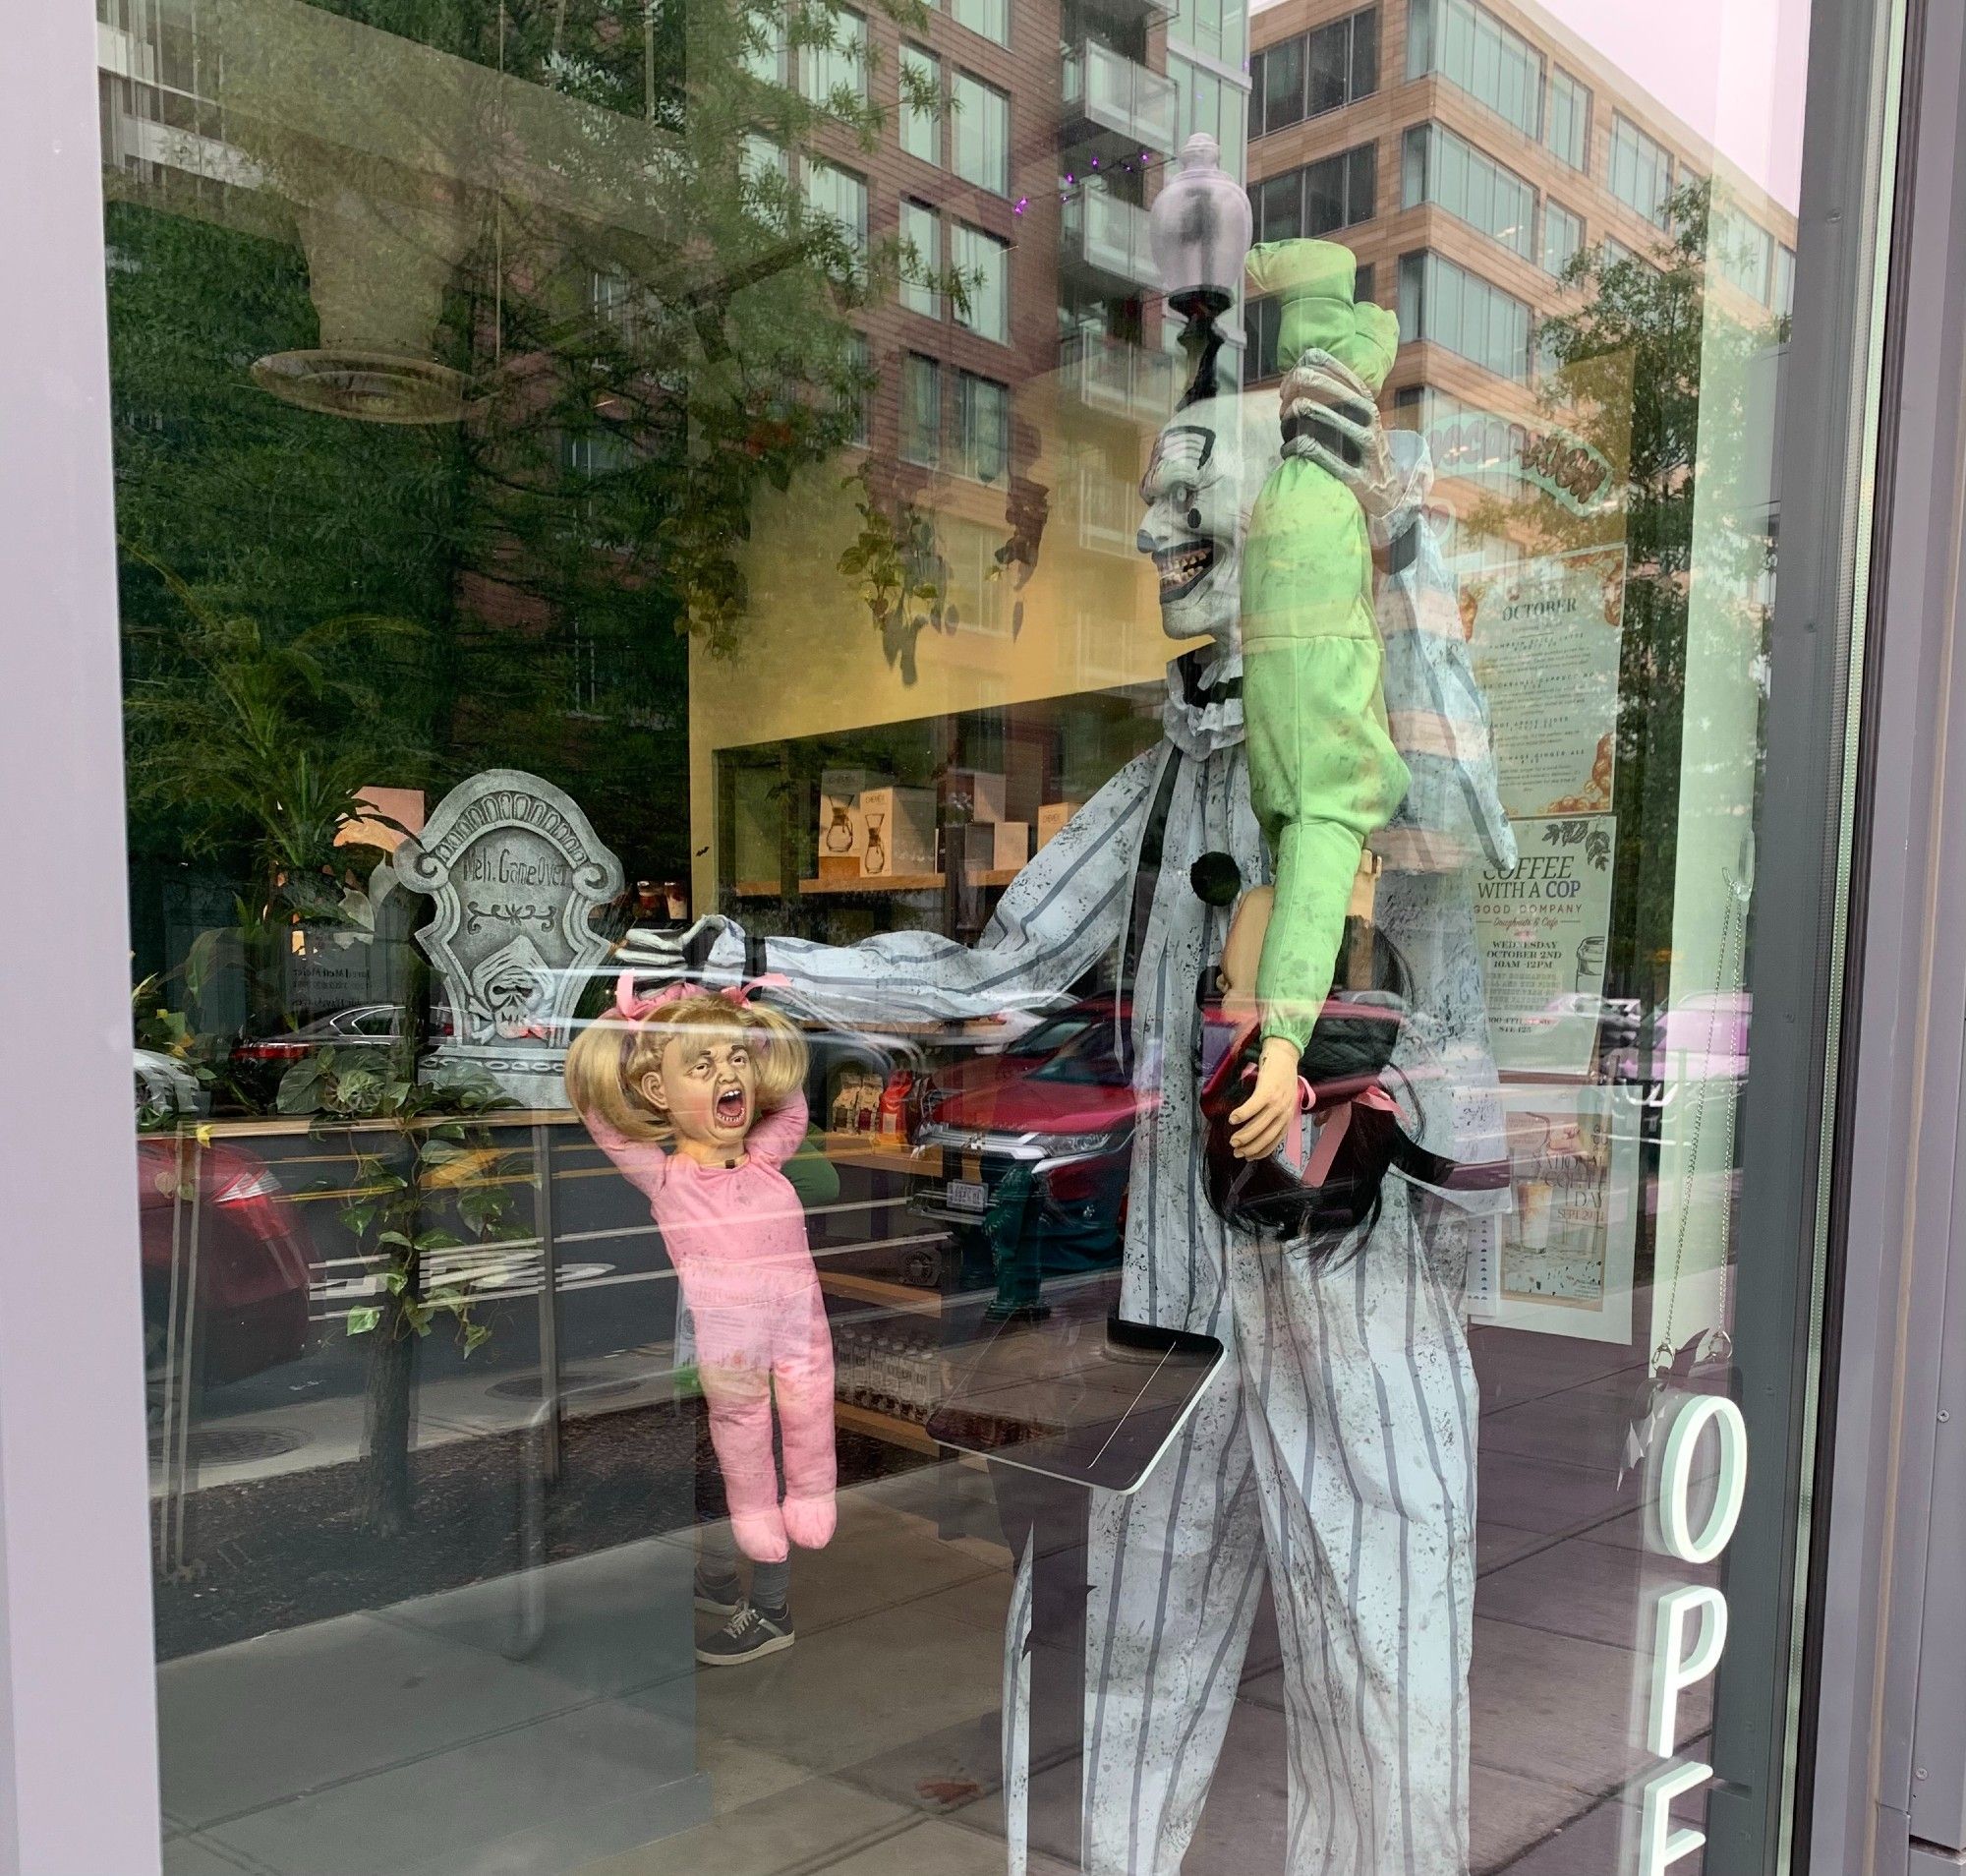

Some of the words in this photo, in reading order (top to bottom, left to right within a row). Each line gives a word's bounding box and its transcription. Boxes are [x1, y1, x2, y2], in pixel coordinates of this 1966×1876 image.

[1502, 598, 1577, 621] OCTOBER
[498, 849, 538, 886] Game
[1477, 883, 1526, 899] WITH
[1527, 881, 1542, 898] A
[1545, 880, 1581, 899] COP
[1473, 904, 1511, 914] GOOD
[1519, 904, 1583, 914] COMPANY
[1486, 950, 1537, 959] OCTOBER
[1539, 950, 1563, 960] 2ND
[1493, 960, 1521, 969] 10AM
[1574, 1191, 1605, 1208] DAY
